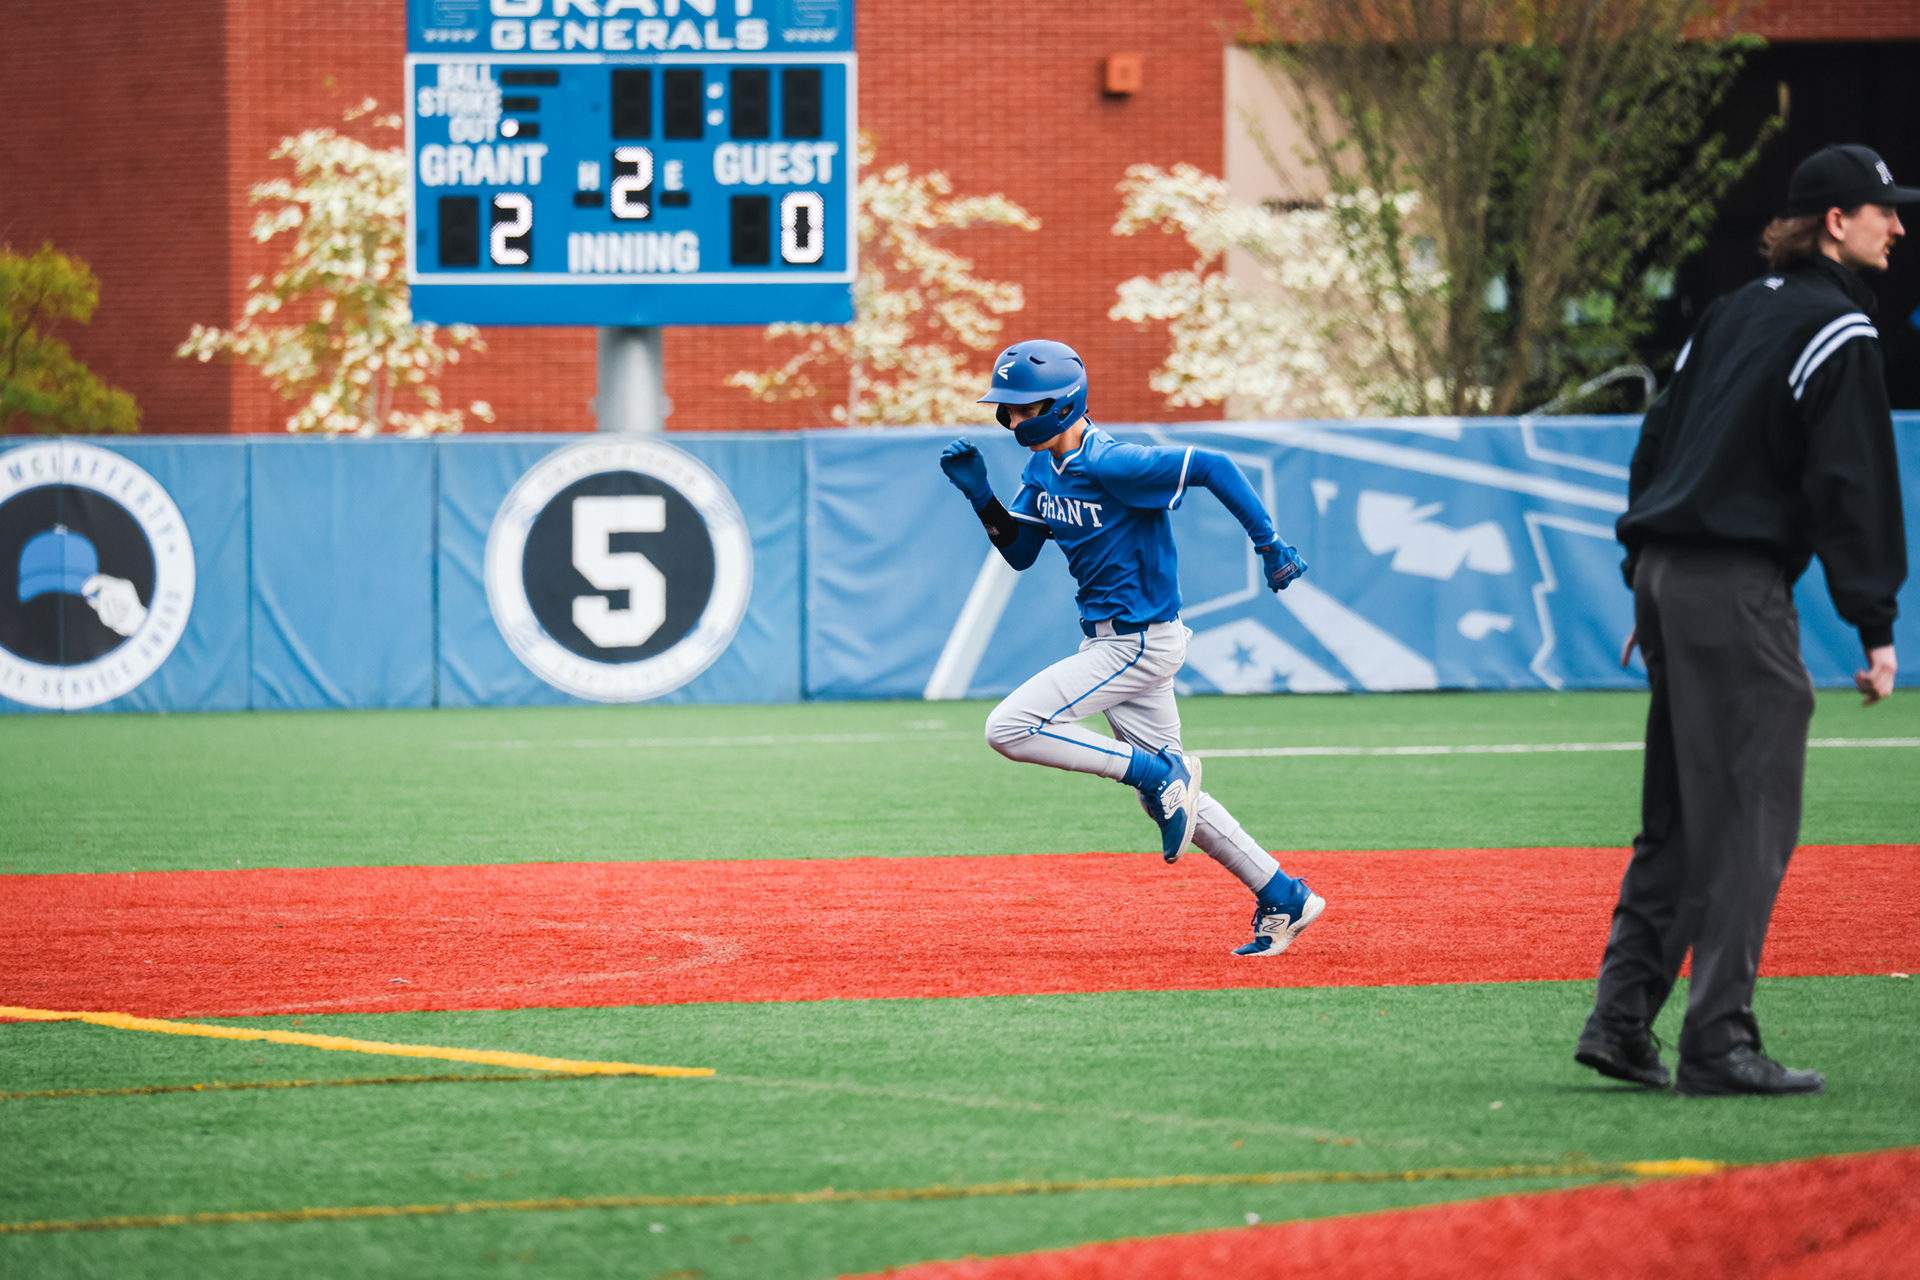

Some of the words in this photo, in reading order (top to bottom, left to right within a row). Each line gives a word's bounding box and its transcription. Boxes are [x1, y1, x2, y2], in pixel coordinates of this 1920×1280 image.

[490, 19, 769, 50] GENERALS
[437, 64, 497, 91] BALL
[418, 86, 502, 118] STRIKE
[449, 116, 498, 144] OUT
[419, 143, 548, 186] GRANT
[578, 160, 600, 191] H
[611, 146, 653, 218] 2
[664, 160, 684, 191] E
[713, 142, 838, 185] GUEST
[490, 192, 532, 265] 2
[781, 191, 824, 263] 0
[567, 231, 700, 273] INNING
[572, 495, 667, 648] 5
